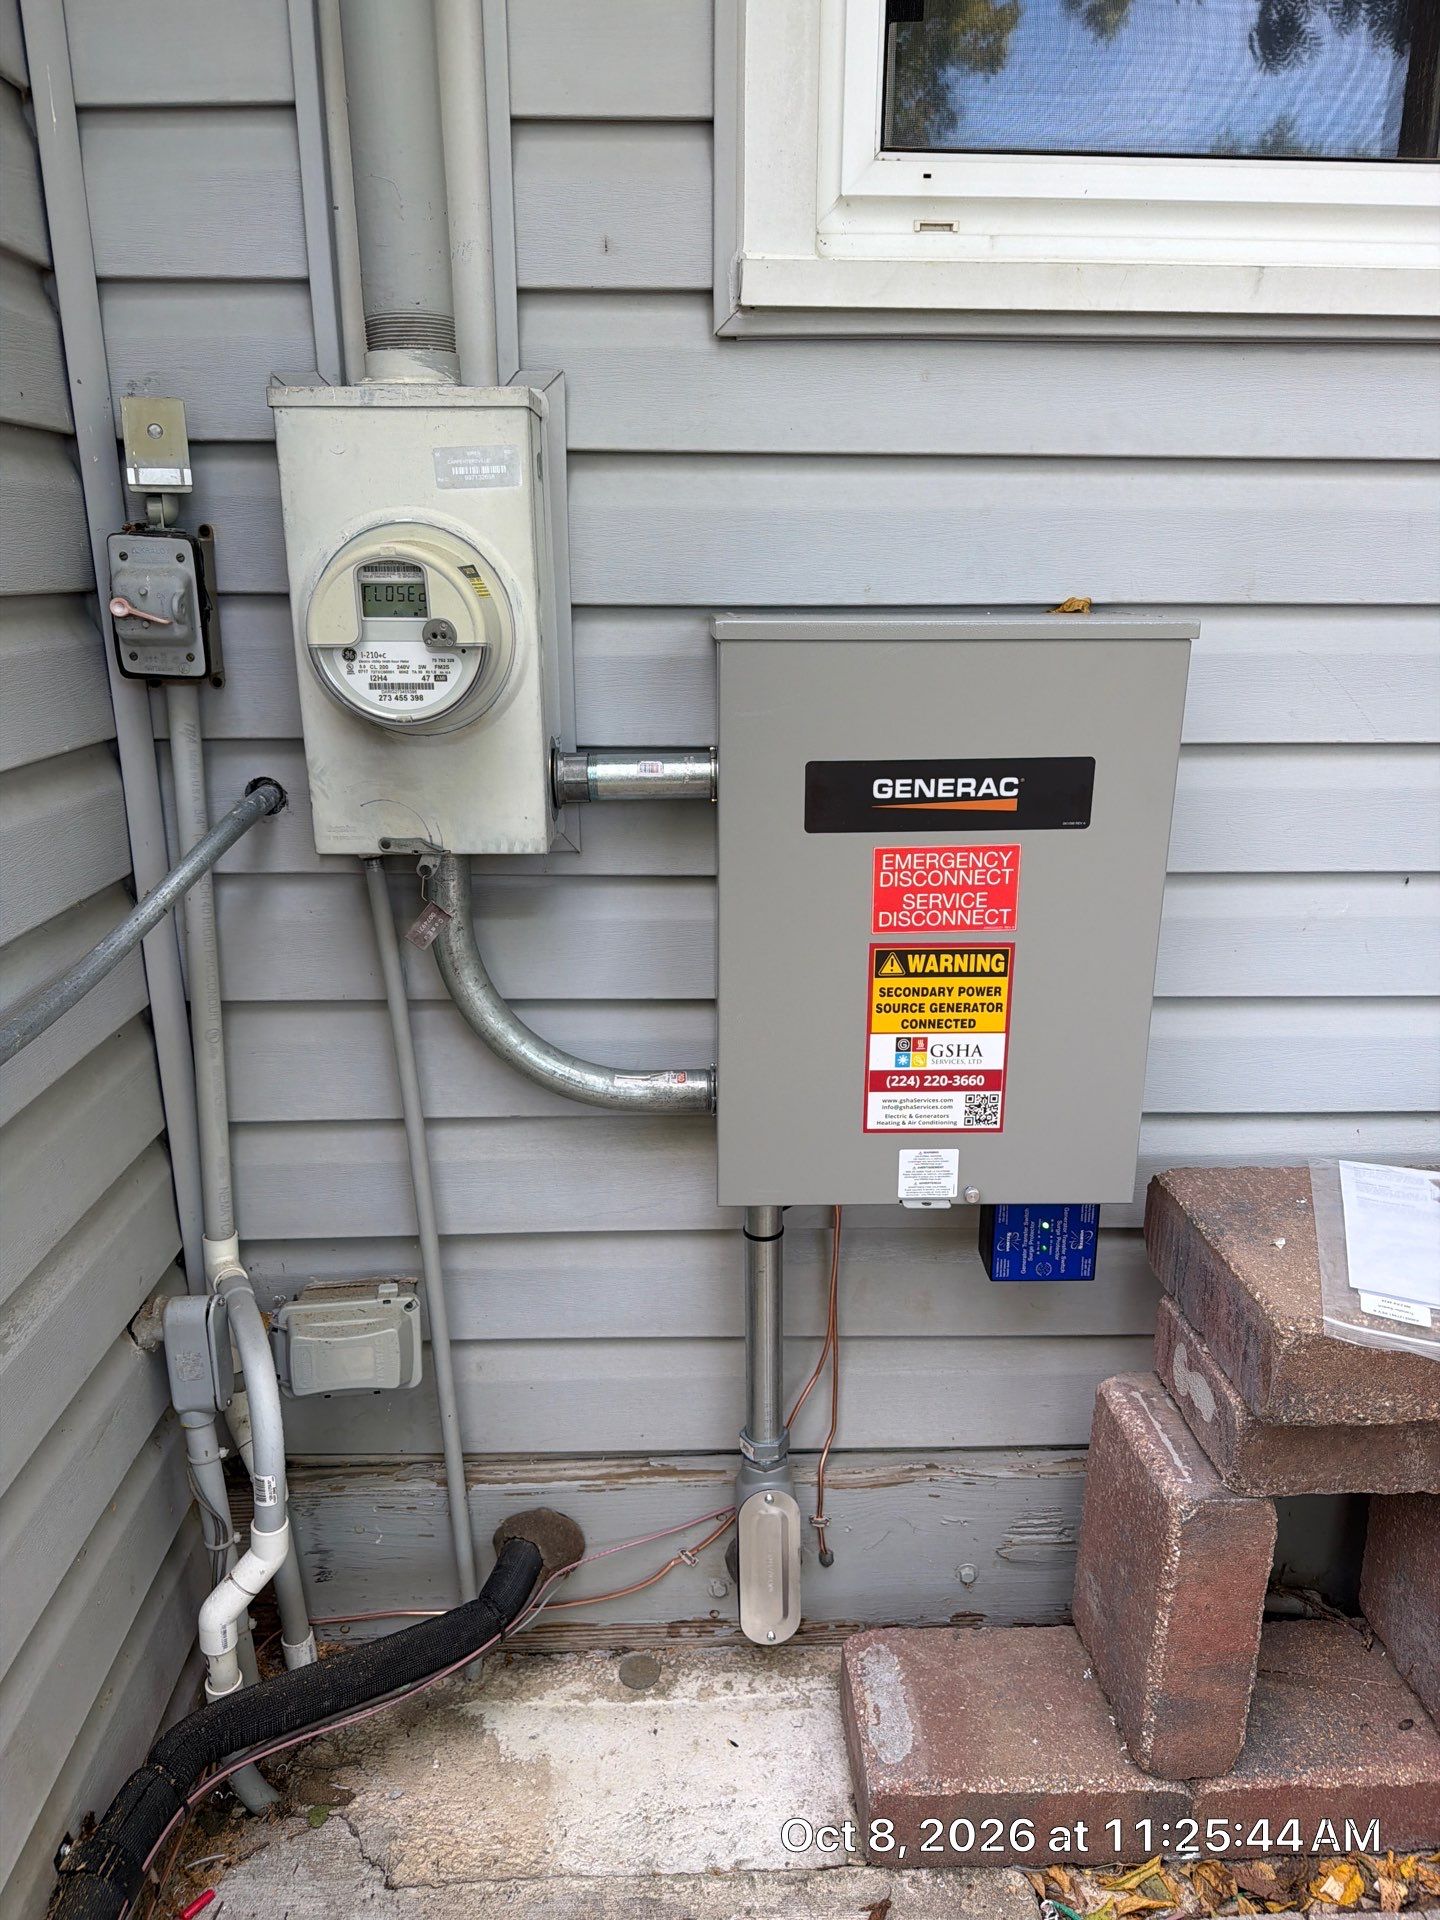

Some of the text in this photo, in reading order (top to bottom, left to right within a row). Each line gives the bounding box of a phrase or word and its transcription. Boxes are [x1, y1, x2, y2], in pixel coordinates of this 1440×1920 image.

[872, 778, 1019, 798] GENERAC
[882, 851, 1013, 870] EMERGENCY
[879, 868, 1014, 888] DISCONNECT
[902, 892, 988, 910] SERVICE
[878, 909, 1012, 928] DISCONNECT
[907, 954, 1006, 973] WARNING
[878, 986, 1002, 998] SECONDARY POWER
[876, 1002, 1003, 1014] SOURCE GENERATOR
[901, 1019, 976, 1029] CONNECTED
[930, 1044, 983, 1058] GSHA
[886, 1075, 984, 1088] (224) 220-3660
